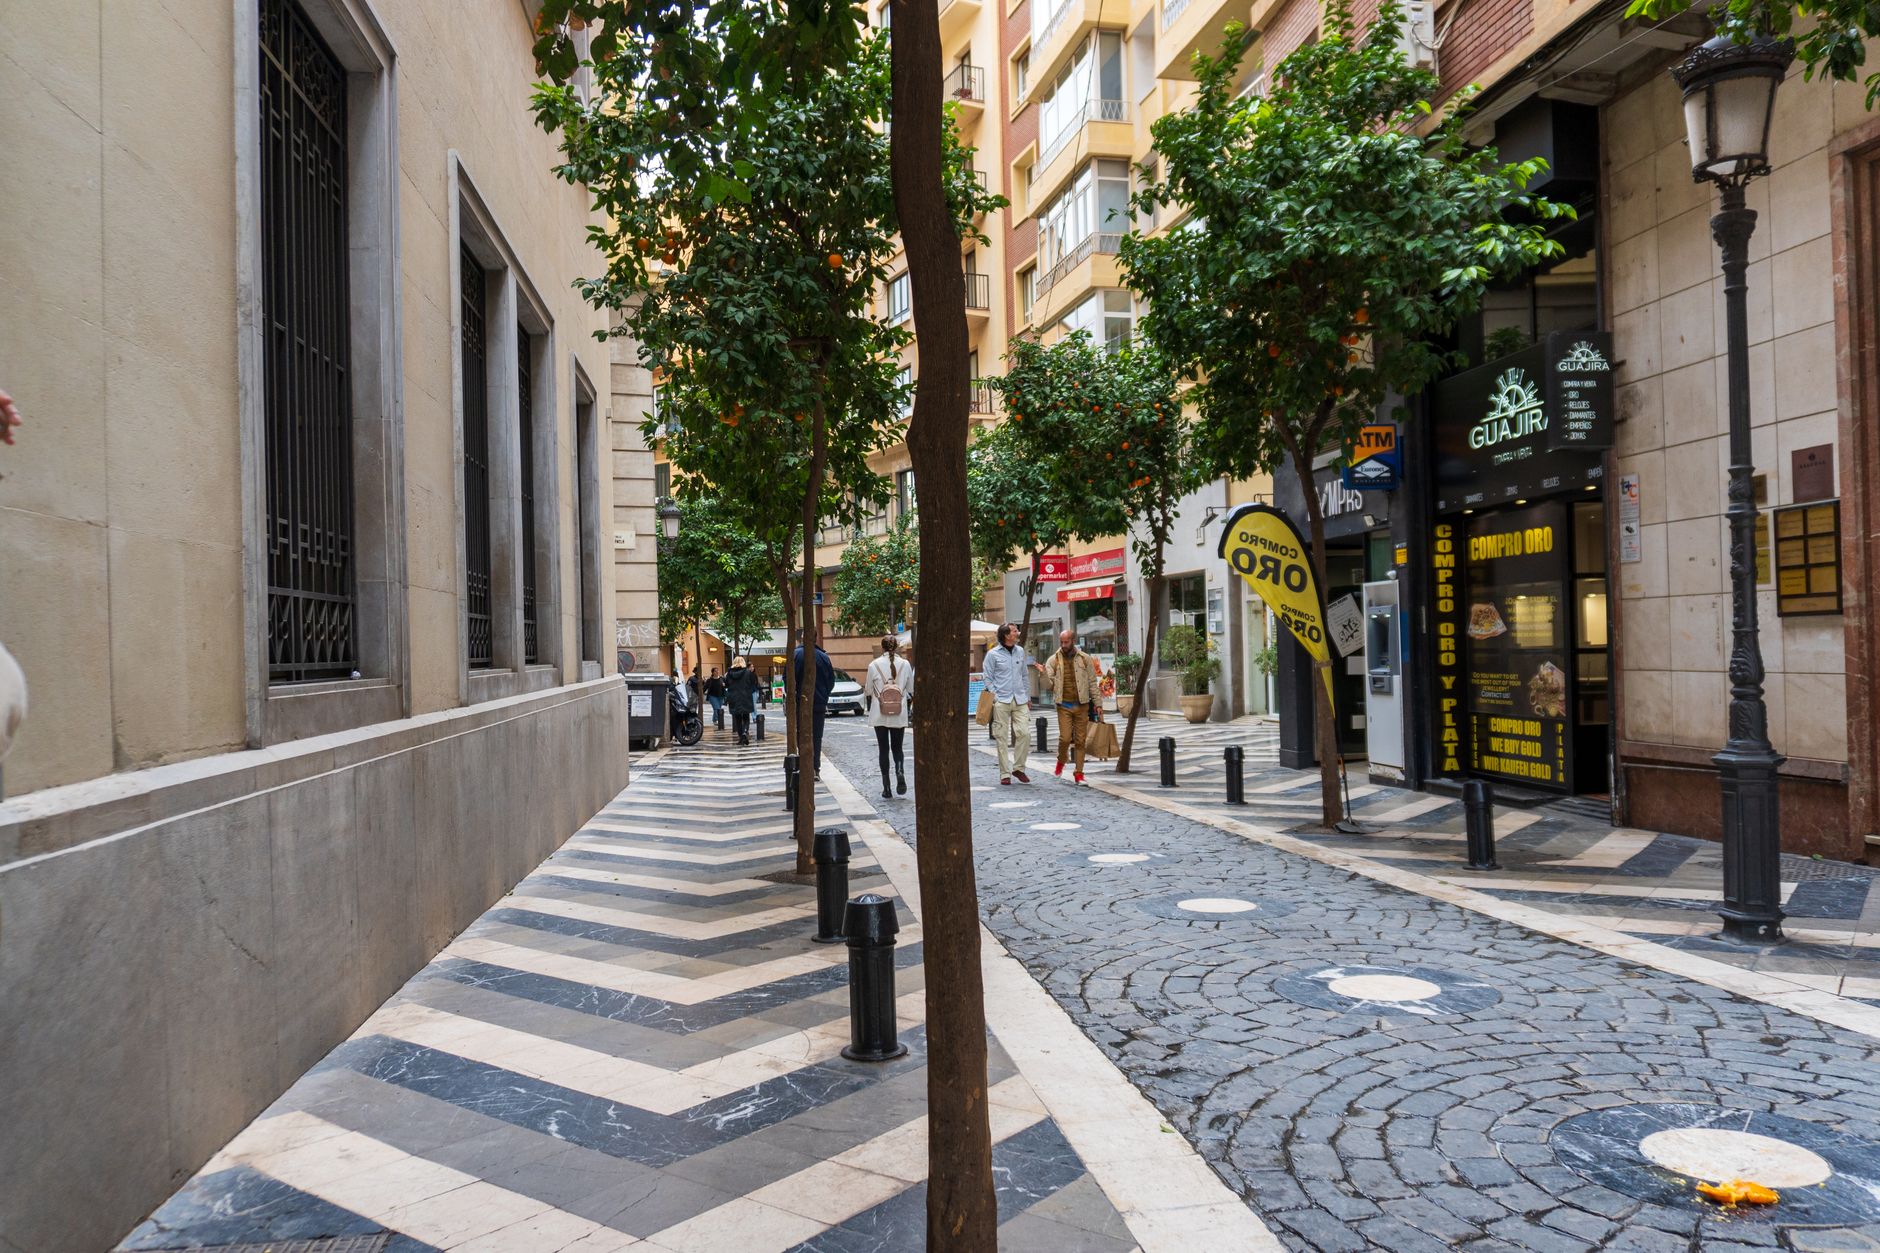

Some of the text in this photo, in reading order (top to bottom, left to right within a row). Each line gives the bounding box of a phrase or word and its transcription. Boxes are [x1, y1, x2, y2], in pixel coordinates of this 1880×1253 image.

[1558, 361, 1610, 371] GUAJIRA
[1568, 391, 1579, 399] ORO
[1568, 401, 1590, 409] RELOJES
[1569, 411, 1596, 420] DIAMANTES
[1569, 421, 1592, 430] EMPEÑOS
[1469, 408, 1549, 450] GUAJIR
[1360, 465, 1385, 473] Euronet
[1470, 526, 1553, 561] COMPRO ORO
[1434, 524, 1460, 772] COMPRO ORO Y PLATA
[1490, 717, 1542, 737] COMPRO ORO
[1491, 737, 1542, 758] WE BUY GOLD
[1556, 723, 1565, 783] PLATA
[1483, 755, 1552, 780] WIR KAUFEN GOLD
